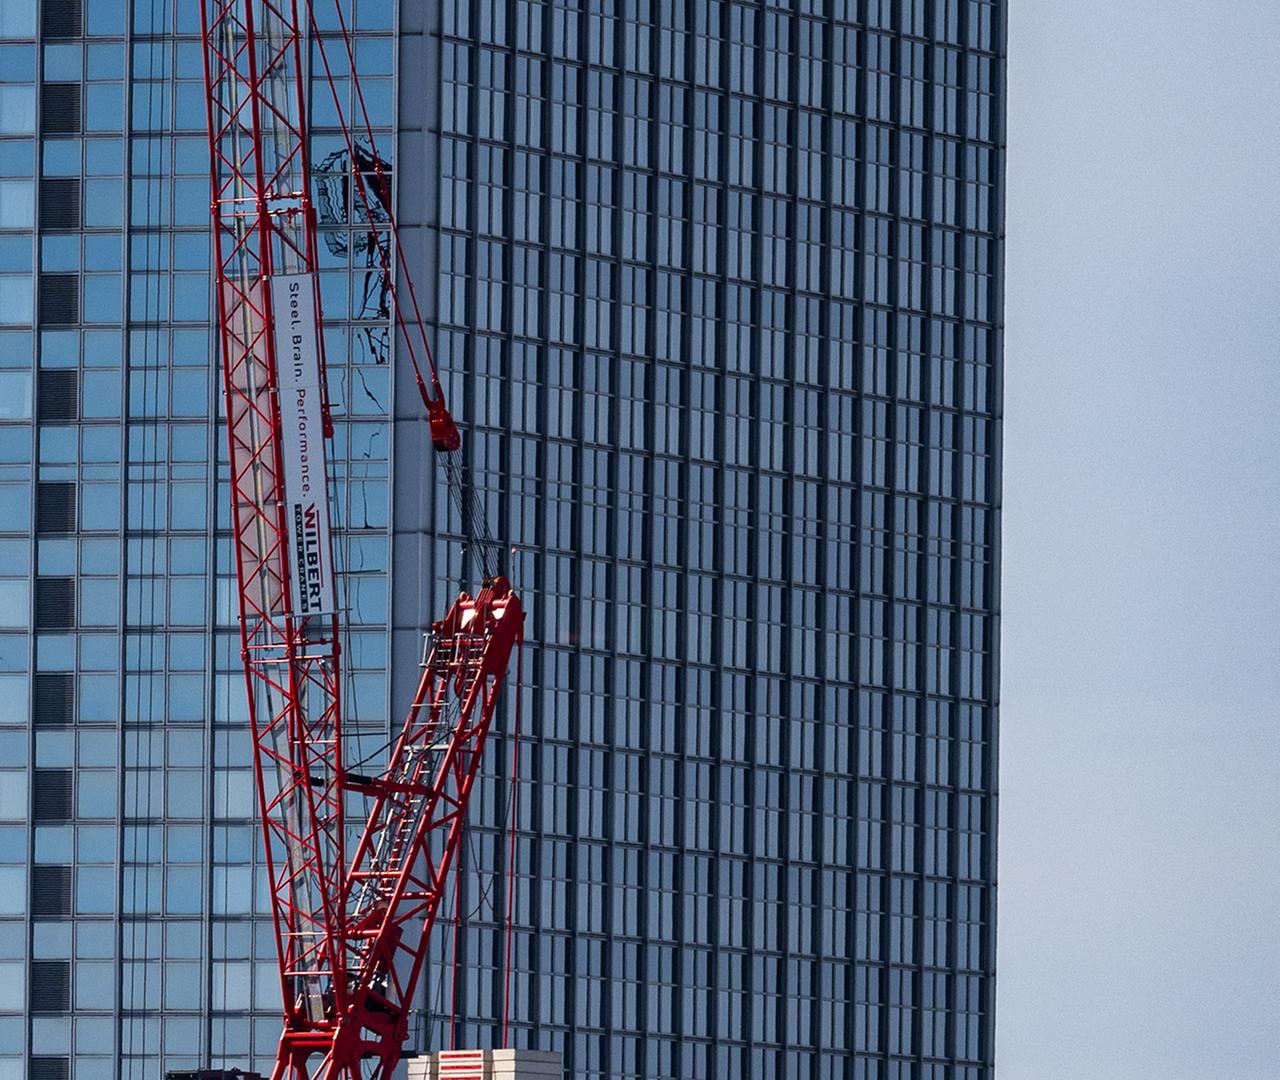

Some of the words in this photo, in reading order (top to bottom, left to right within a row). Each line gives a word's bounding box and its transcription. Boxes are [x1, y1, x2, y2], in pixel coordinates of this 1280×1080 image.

[289, 282, 302, 330] Steel.
[292, 335, 304, 382] Brain.
[296, 388, 311, 497] Performance.
[295, 506, 304, 553] TOWER
[304, 502, 322, 612] WILBERT
